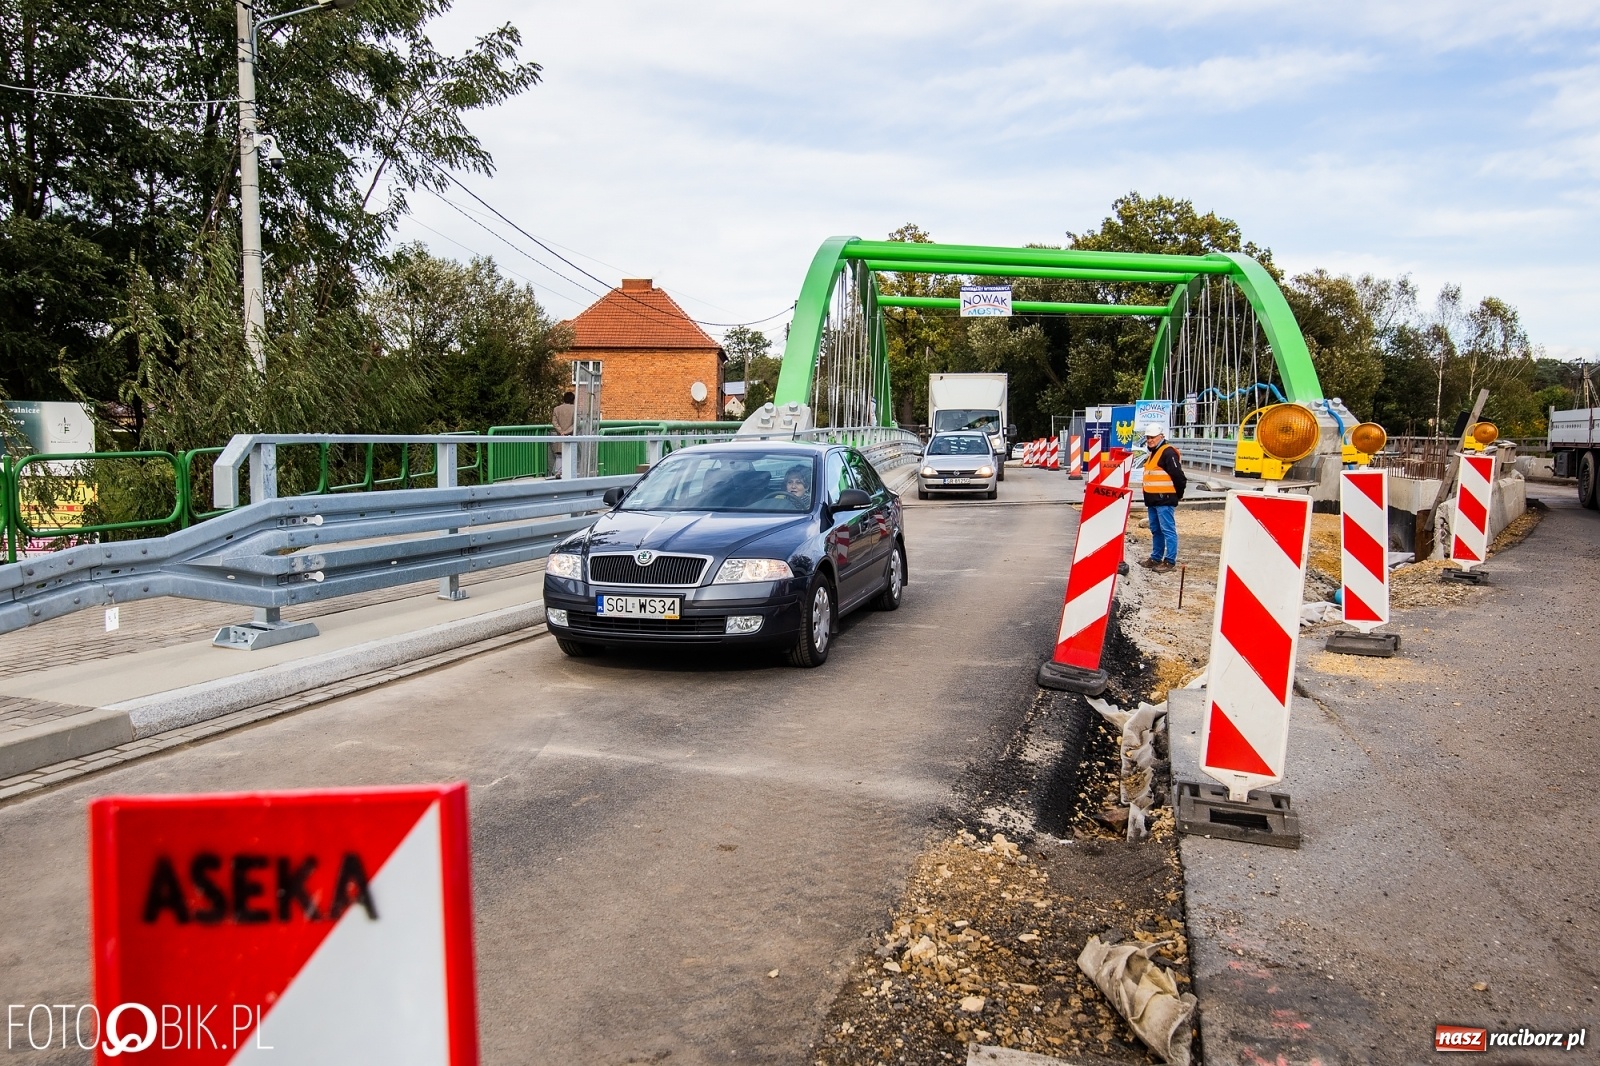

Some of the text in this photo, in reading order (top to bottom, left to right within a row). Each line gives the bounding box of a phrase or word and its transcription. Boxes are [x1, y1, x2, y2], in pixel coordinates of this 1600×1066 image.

[963, 294, 1008, 308] NOWAK
[1140, 402, 1166, 413] NOWAK
[1093, 487, 1125, 499] ASEKA
[606, 597, 676, 615] SGL WS34
[141, 852, 380, 926] ASEKA
